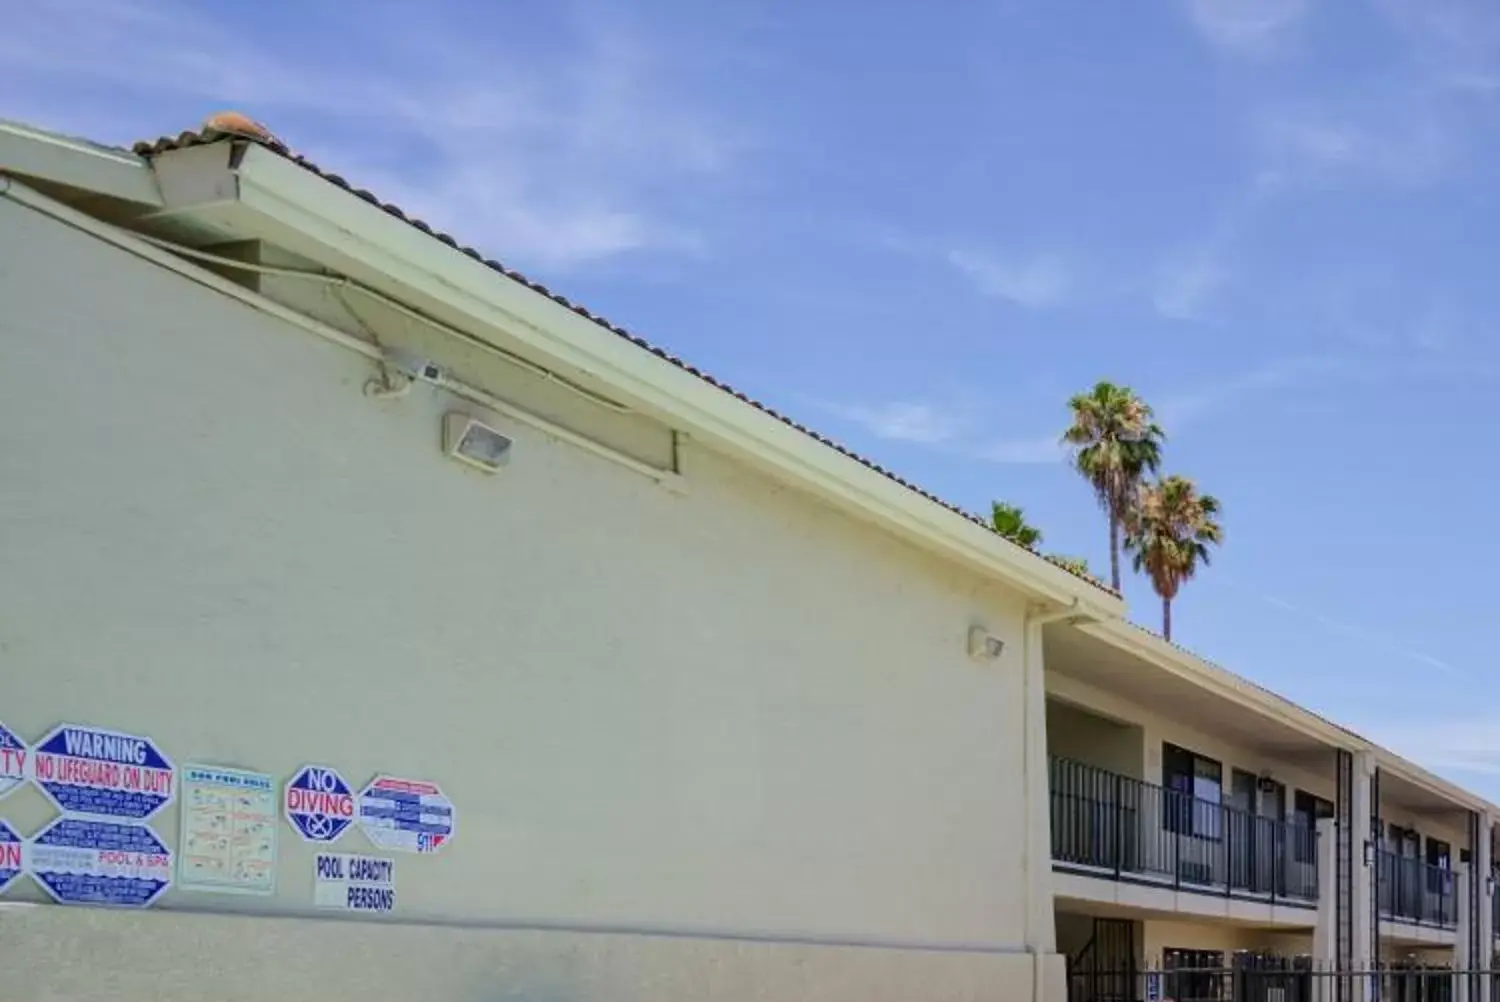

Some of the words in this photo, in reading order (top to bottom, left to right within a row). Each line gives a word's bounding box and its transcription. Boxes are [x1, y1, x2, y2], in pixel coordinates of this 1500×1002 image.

[64, 728, 147, 764] WARNING
[35, 755, 53, 779] NO
[57, 757, 120, 787] LIFEGUARD
[123, 765, 140, 790] ON
[144, 770, 173, 796] DUTY
[308, 768, 336, 791] NO
[287, 789, 353, 816] DIVING
[417, 833, 434, 852] 911
[98, 851, 134, 866] POOL
[317, 856, 344, 879] POOL
[349, 858, 393, 882] CAPACITY
[347, 886, 394, 910] PERSONS
